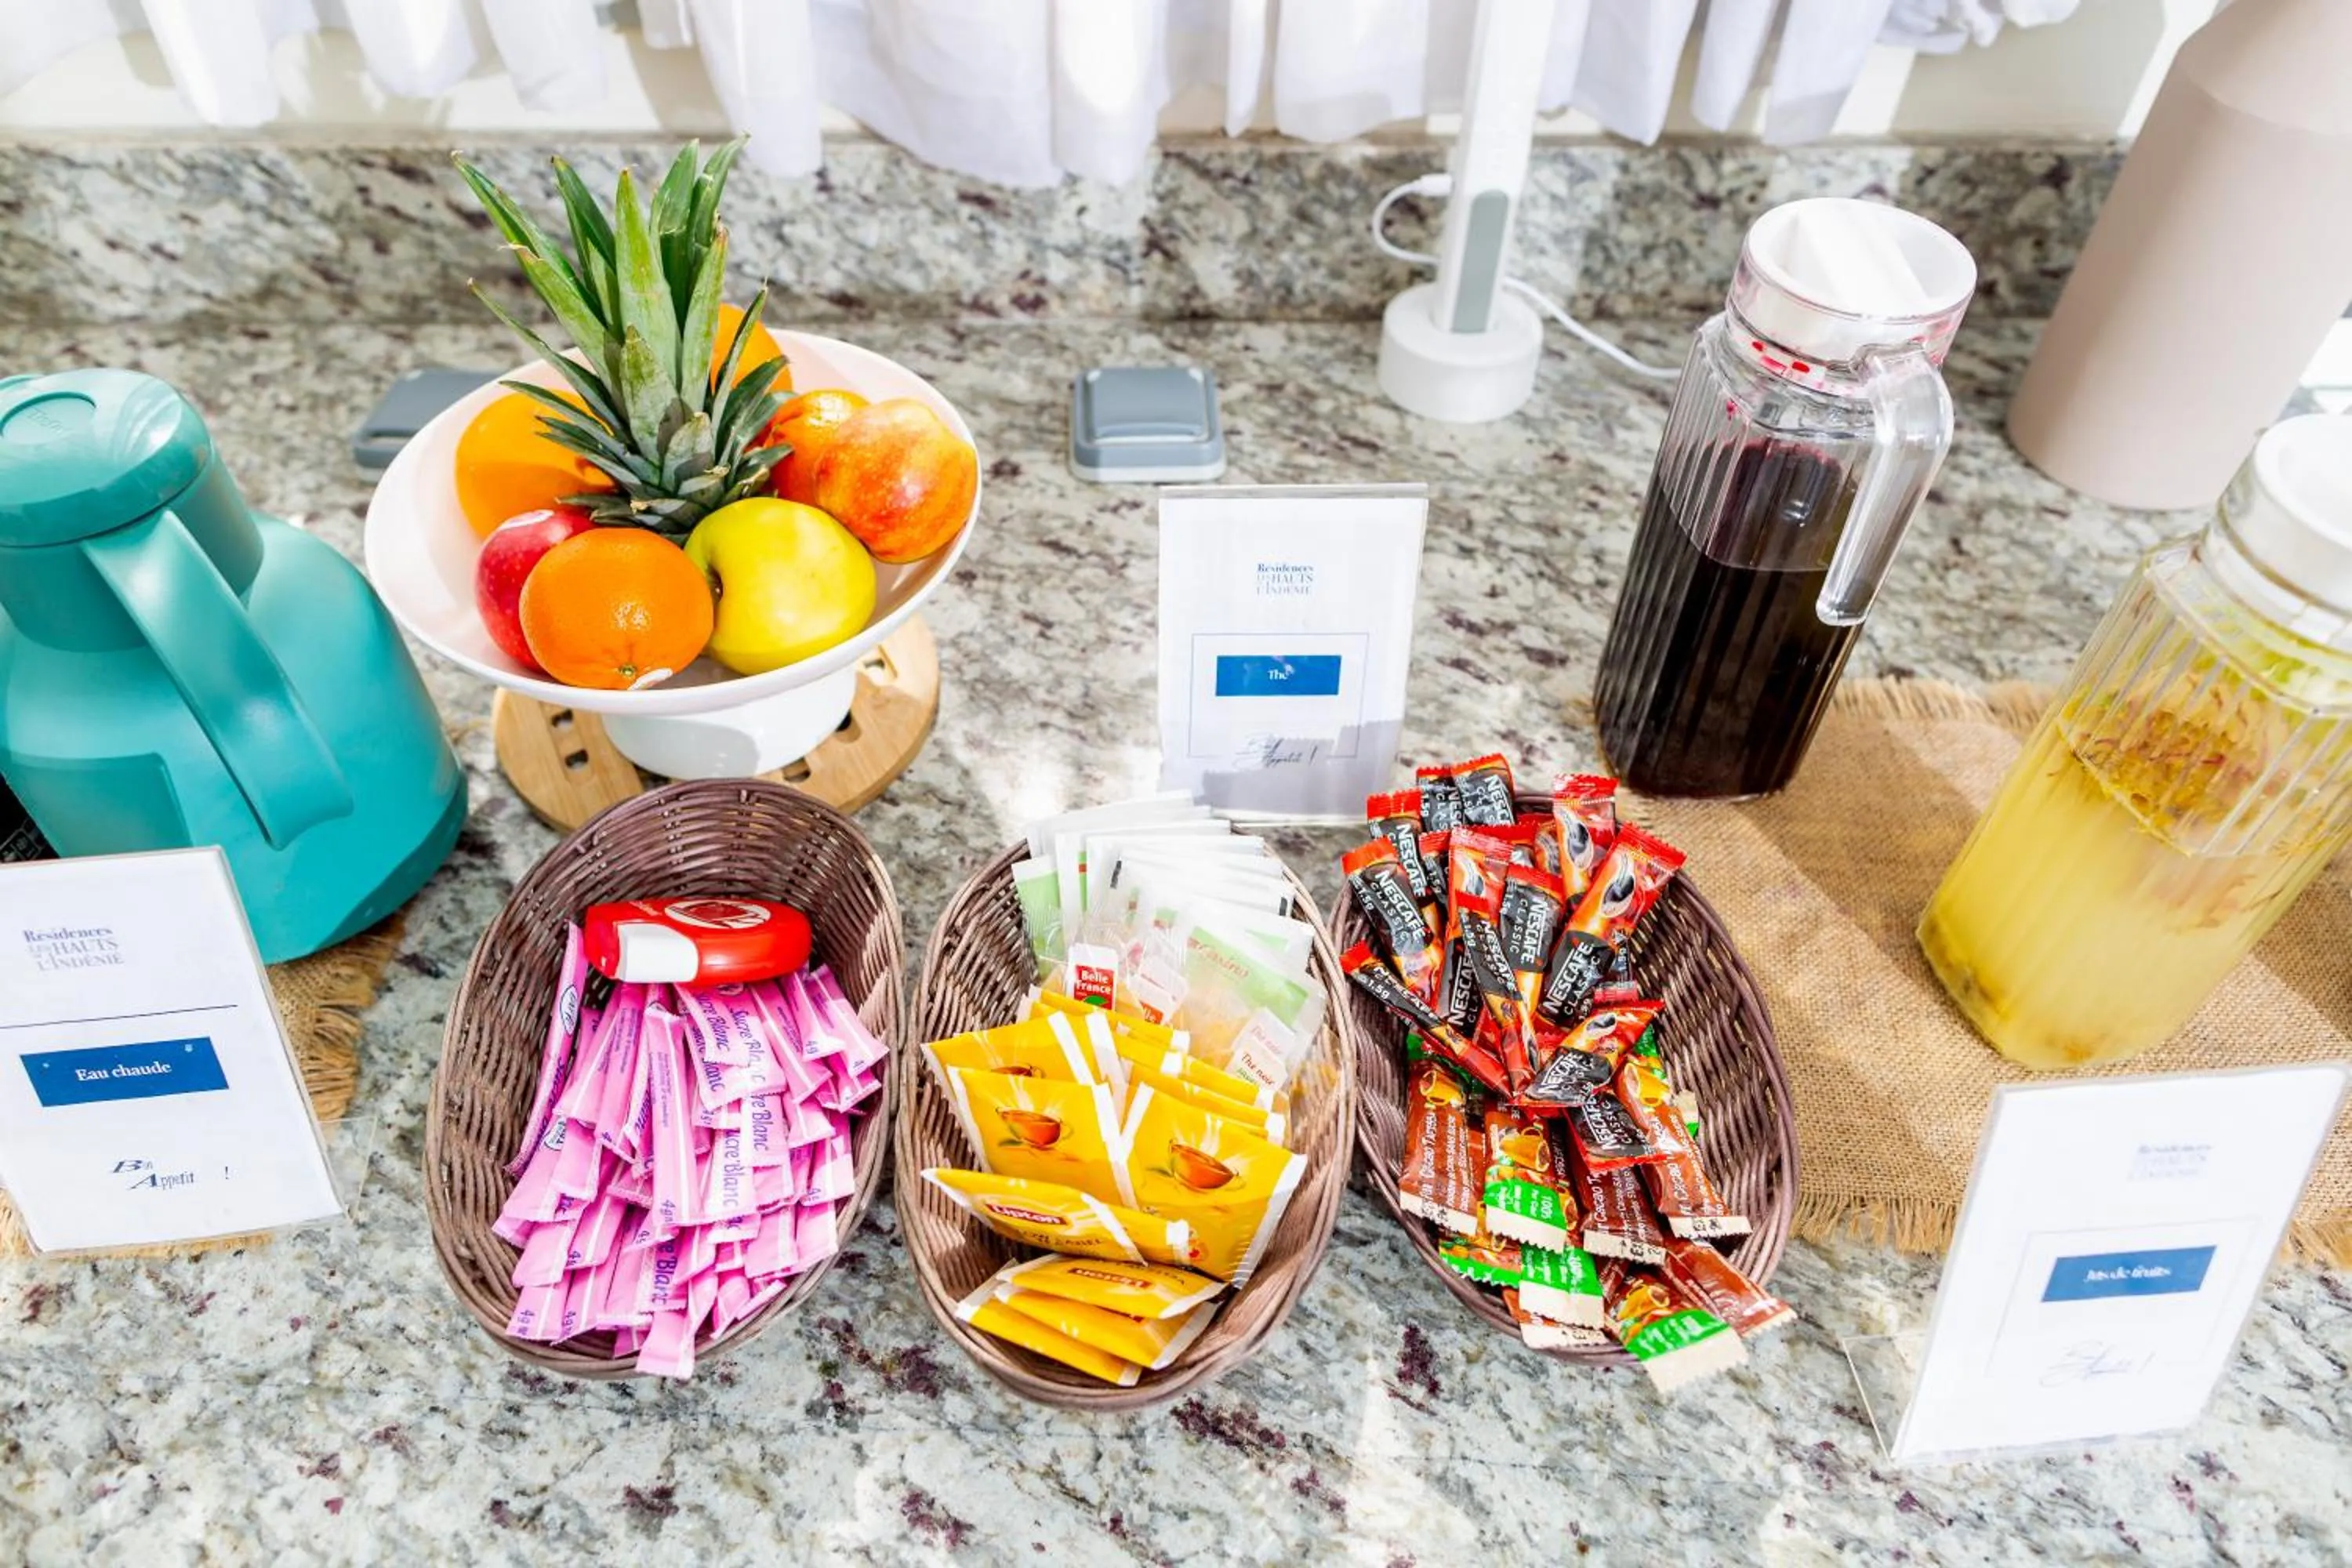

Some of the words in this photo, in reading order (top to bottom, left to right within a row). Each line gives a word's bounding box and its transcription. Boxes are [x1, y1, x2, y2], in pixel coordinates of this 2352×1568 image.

[1370, 882, 1410, 941] CLASSIC
[1508, 898, 1529, 954] CLASSIC
[1076, 980, 1112, 995] France
[1080, 970, 1109, 984] Belle
[1366, 978, 1390, 1000] 1.5g
[1562, 956, 1601, 1016] CLASSIC
[707, 1016, 731, 1052] Blanc
[730, 1007, 753, 1040] Sucre
[75, 1068, 110, 1081] Eau
[112, 1061, 172, 1077] chaude
[752, 1109, 773, 1152] Blanc
[1602, 1098, 1632, 1145] CLASSIC
[722, 1162, 745, 1207] Blanc
[1592, 1185, 1608, 1224] Cacao
[651, 1254, 677, 1305] Blanc
